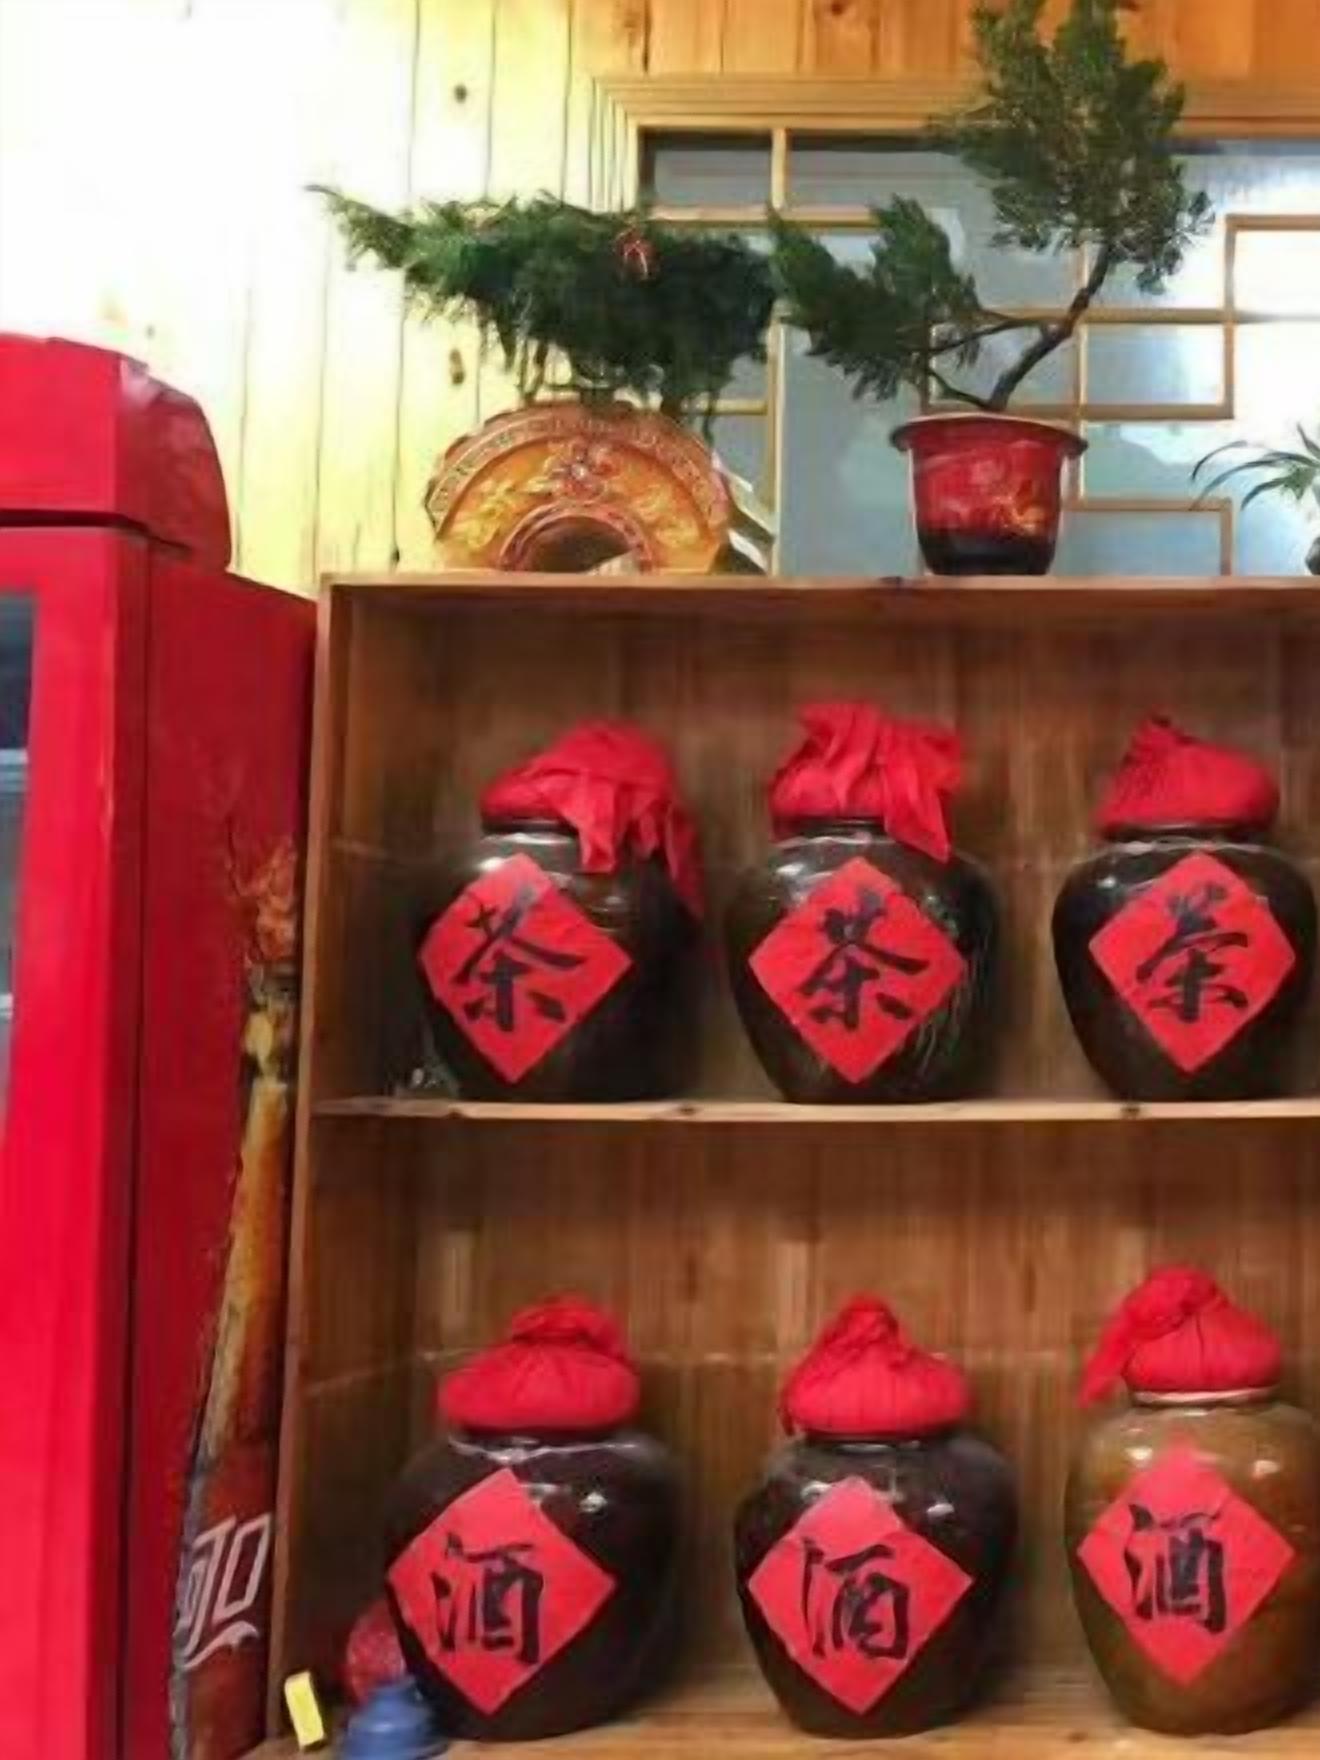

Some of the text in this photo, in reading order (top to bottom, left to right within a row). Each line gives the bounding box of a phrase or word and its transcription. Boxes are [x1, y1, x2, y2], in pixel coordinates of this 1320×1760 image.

[453, 884, 585, 1032] 茶
[800, 886, 928, 1032] 茶
[1136, 884, 1250, 1021] 茶
[430, 1531, 544, 1665] 酒
[801, 1535, 911, 1660] 酒
[1126, 1503, 1228, 1633] 酒
